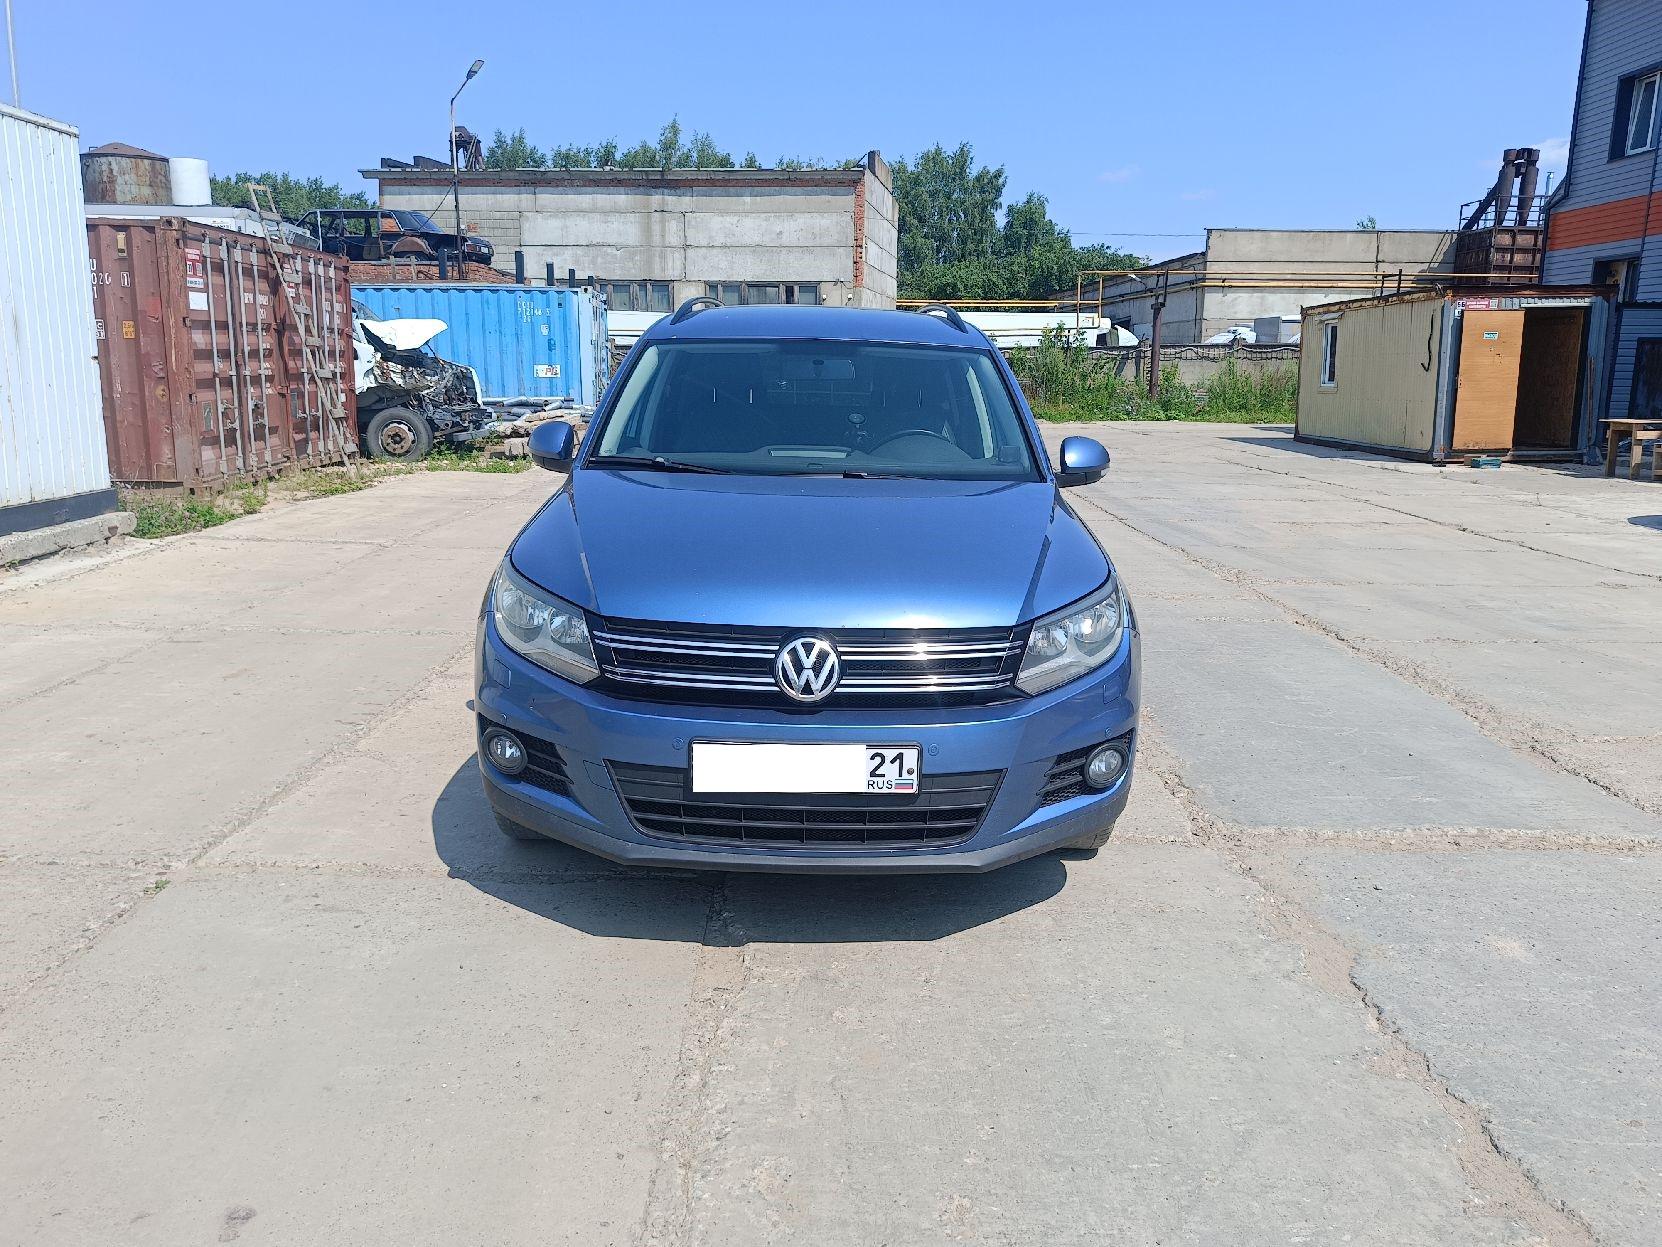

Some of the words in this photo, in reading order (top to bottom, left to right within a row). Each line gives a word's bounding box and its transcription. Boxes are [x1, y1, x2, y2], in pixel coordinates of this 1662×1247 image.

[777, 638, 840, 701] VW
[869, 751, 904, 778] 21
[867, 779, 893, 790] RUS
